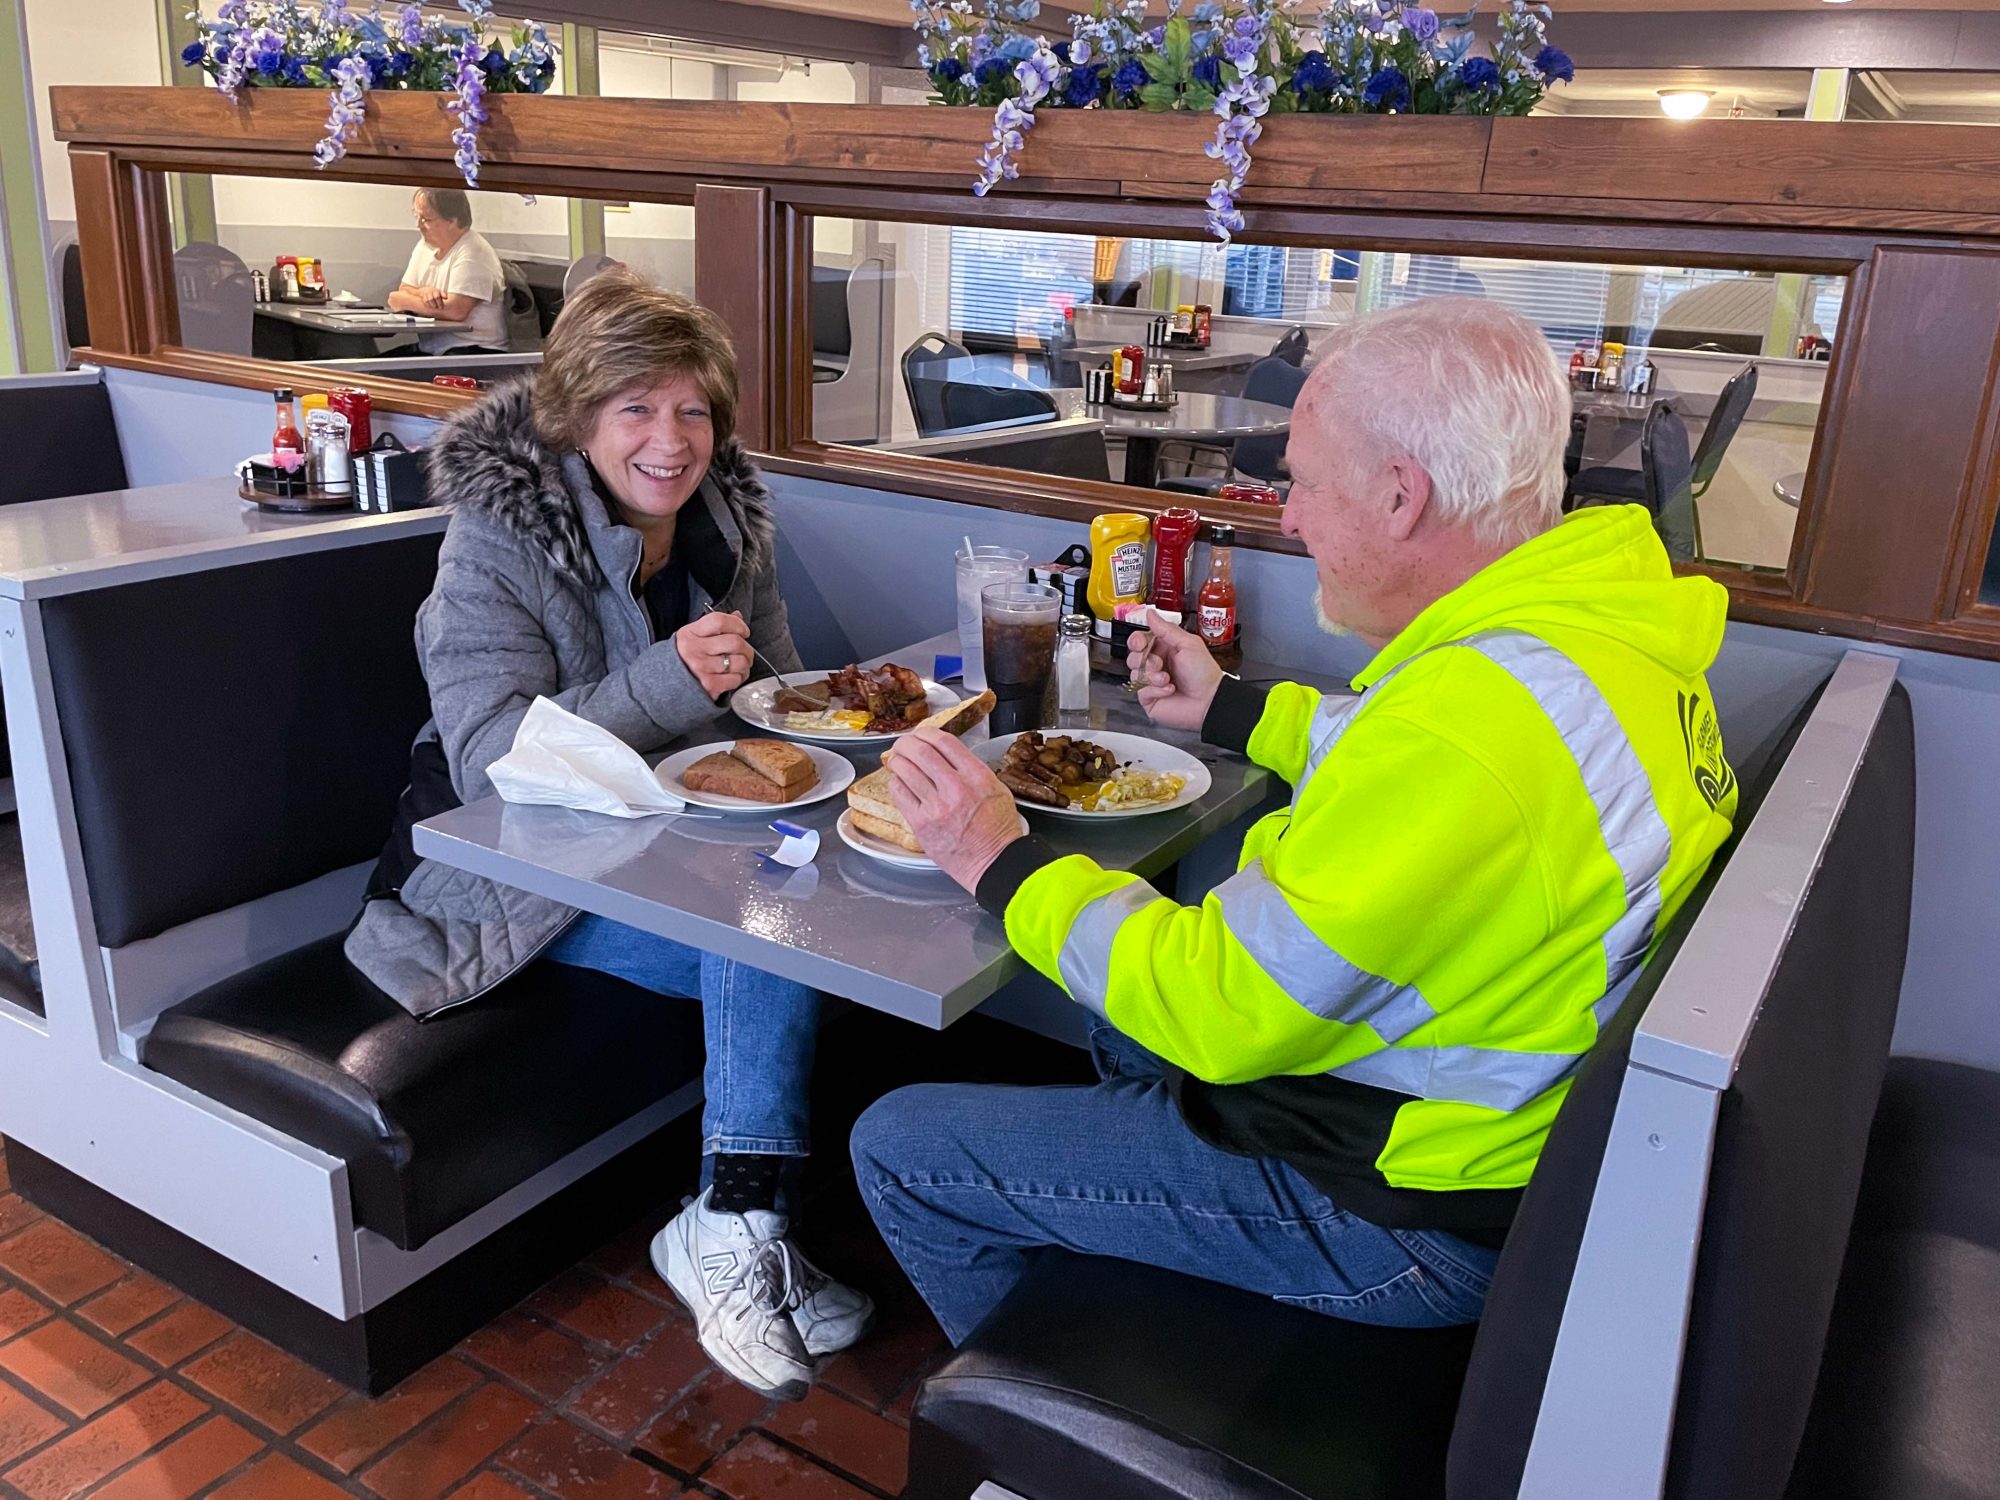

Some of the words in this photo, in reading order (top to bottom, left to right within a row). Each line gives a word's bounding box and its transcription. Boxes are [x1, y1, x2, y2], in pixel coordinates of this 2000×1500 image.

[1121, 547, 1141, 556] HEINZ
[1199, 612, 1232, 628] RedHot
[702, 1251, 746, 1296] N
